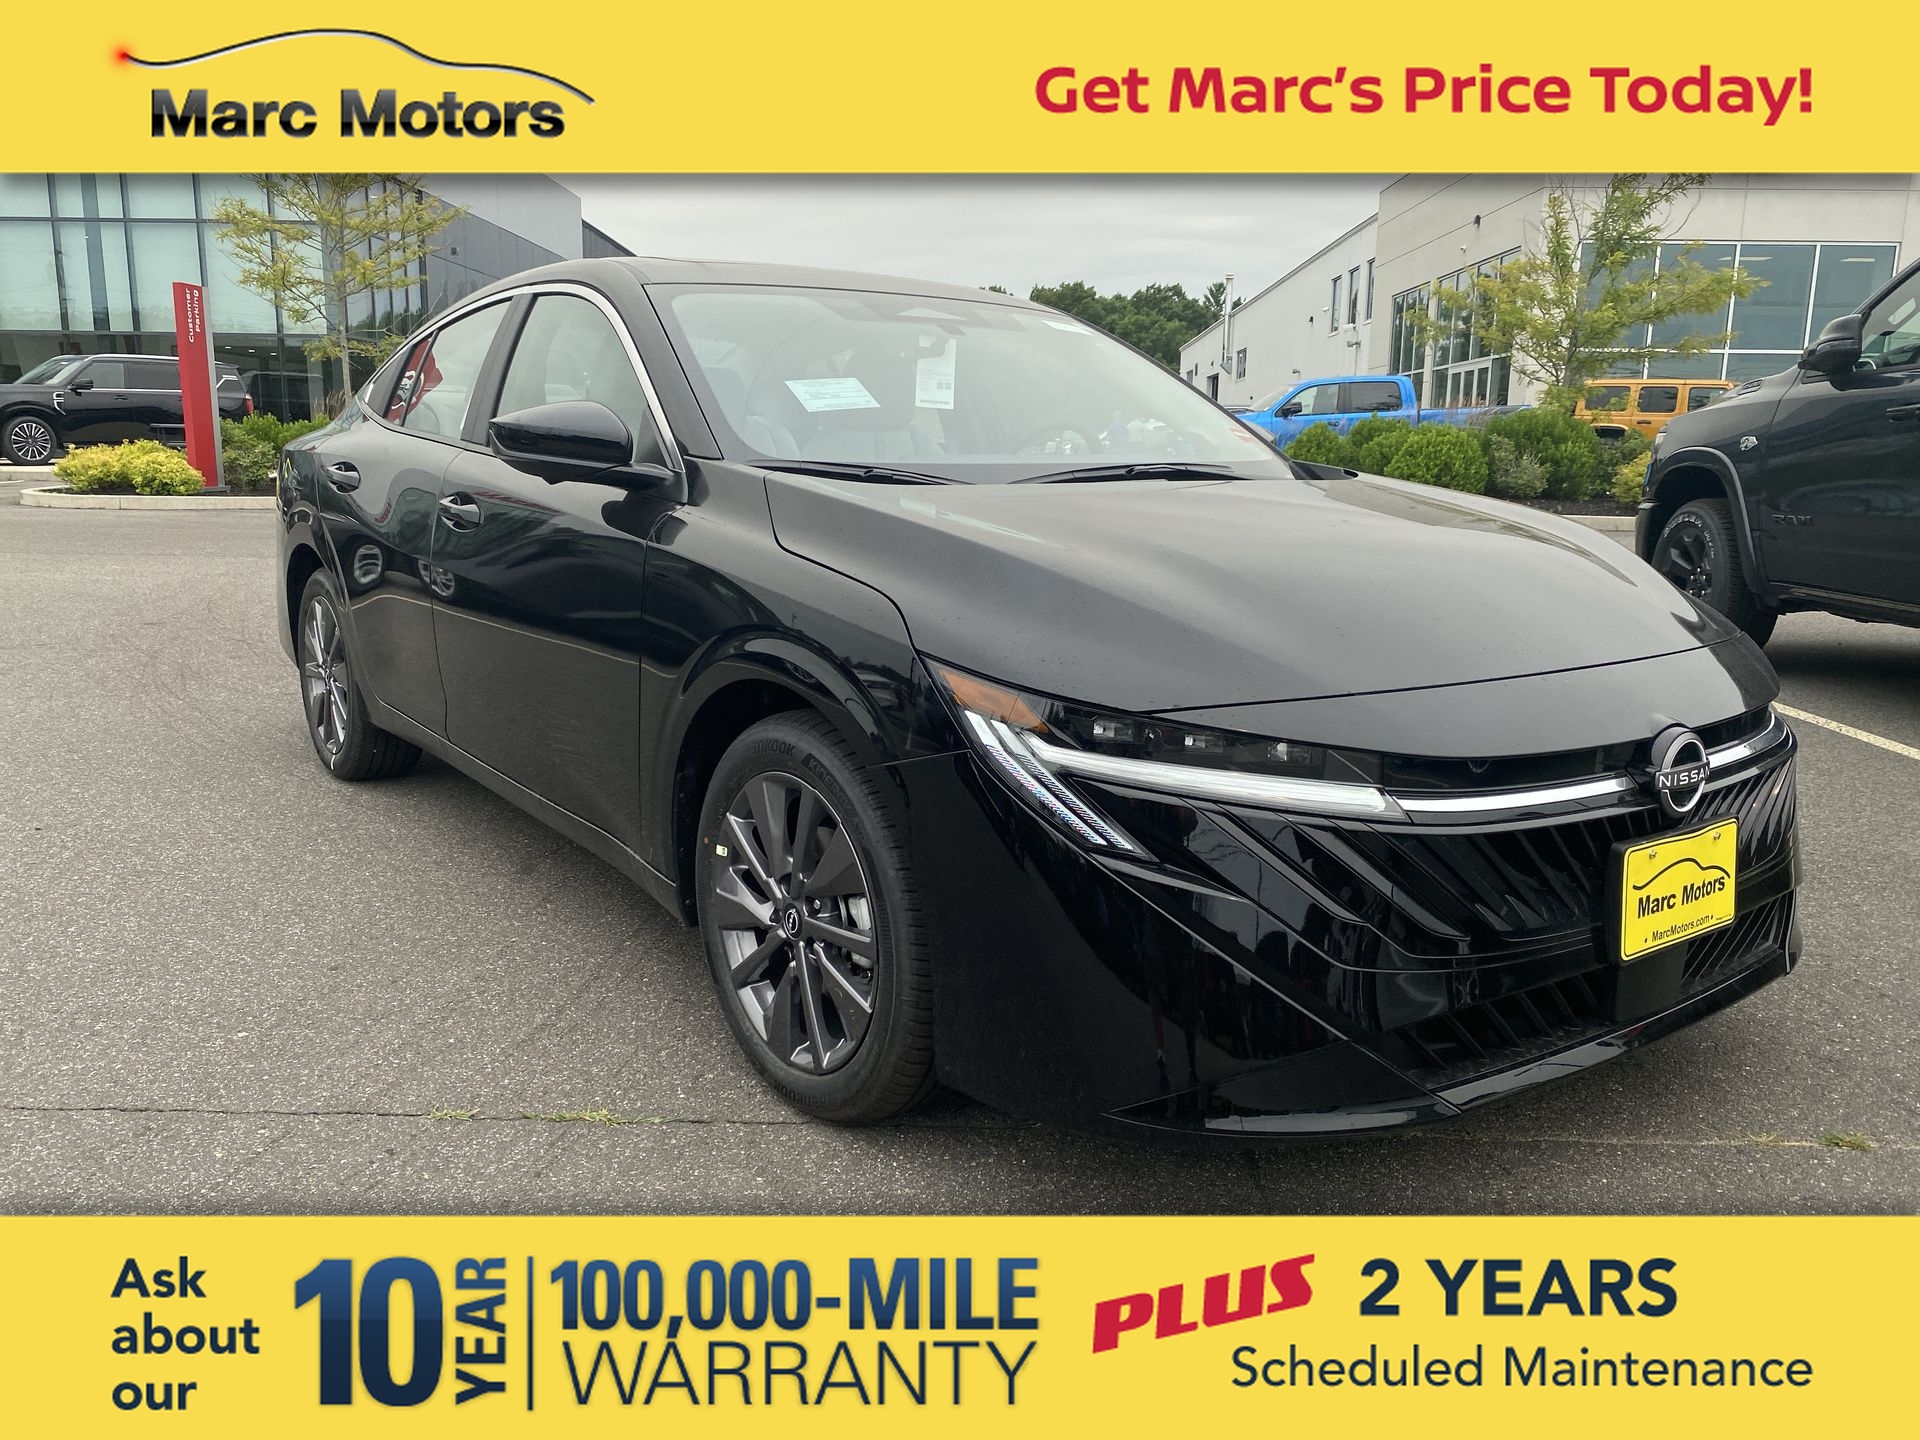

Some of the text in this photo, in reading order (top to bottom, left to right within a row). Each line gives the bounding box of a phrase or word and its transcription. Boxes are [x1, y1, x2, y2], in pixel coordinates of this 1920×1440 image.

[185, 288, 194, 343] Customer
[193, 289, 201, 333] Parking
[1659, 765, 1710, 788] NISSAN
[1637, 875, 1726, 919] Marc Motors
[1651, 914, 1710, 943] MarcMotors.com
